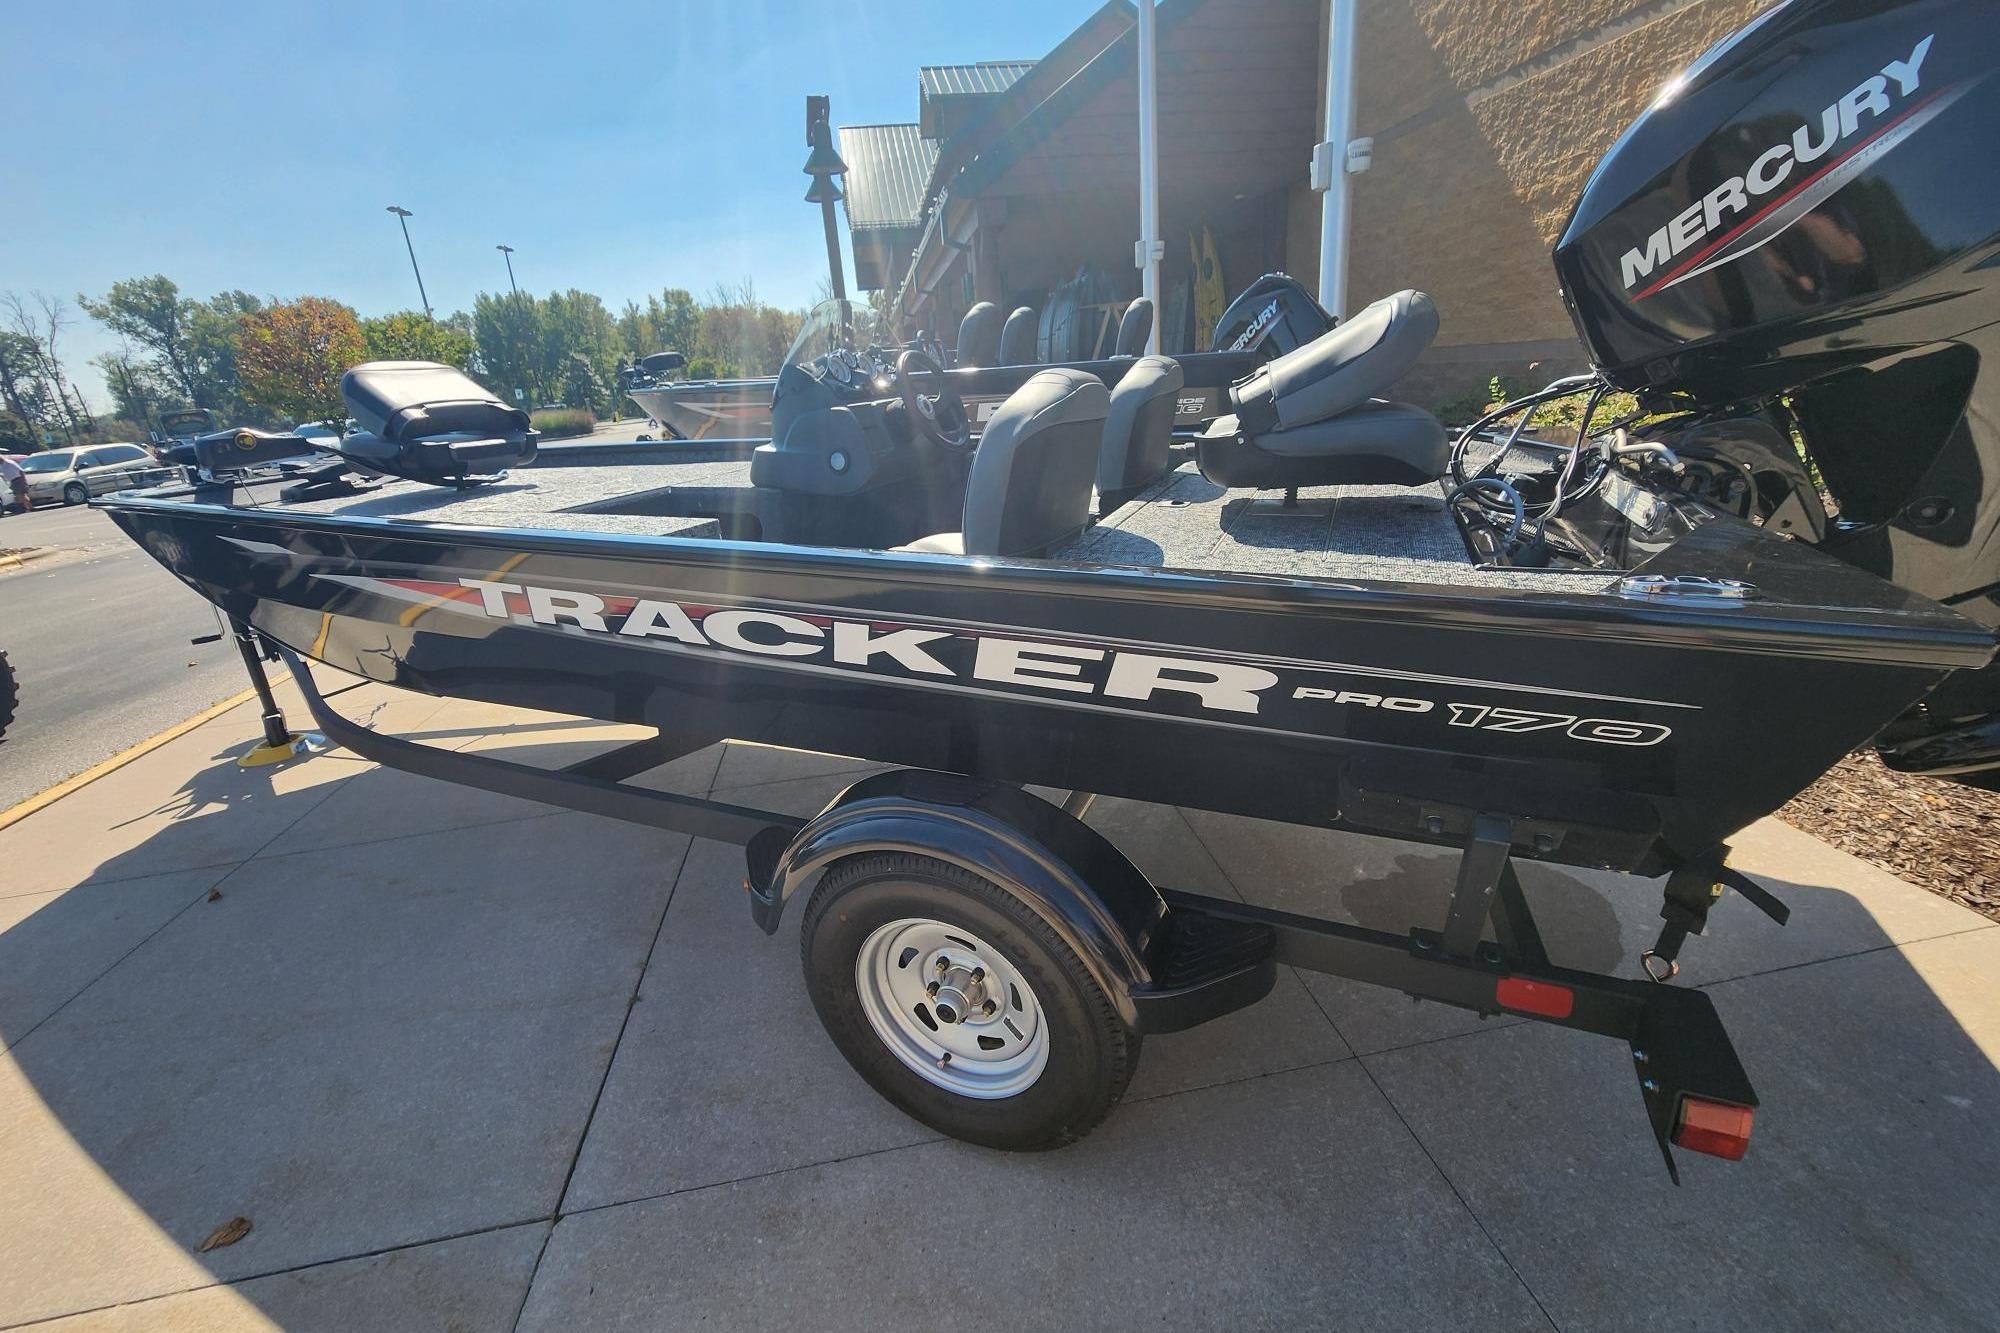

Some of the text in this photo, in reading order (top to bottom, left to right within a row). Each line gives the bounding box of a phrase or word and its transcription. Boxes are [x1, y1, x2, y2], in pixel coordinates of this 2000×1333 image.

[1620, 33, 1934, 289] MERCURY
[1229, 299, 1277, 350] ERCURY
[458, 577, 1279, 714] TRACKER
[1292, 686, 1672, 746] PRO 170
